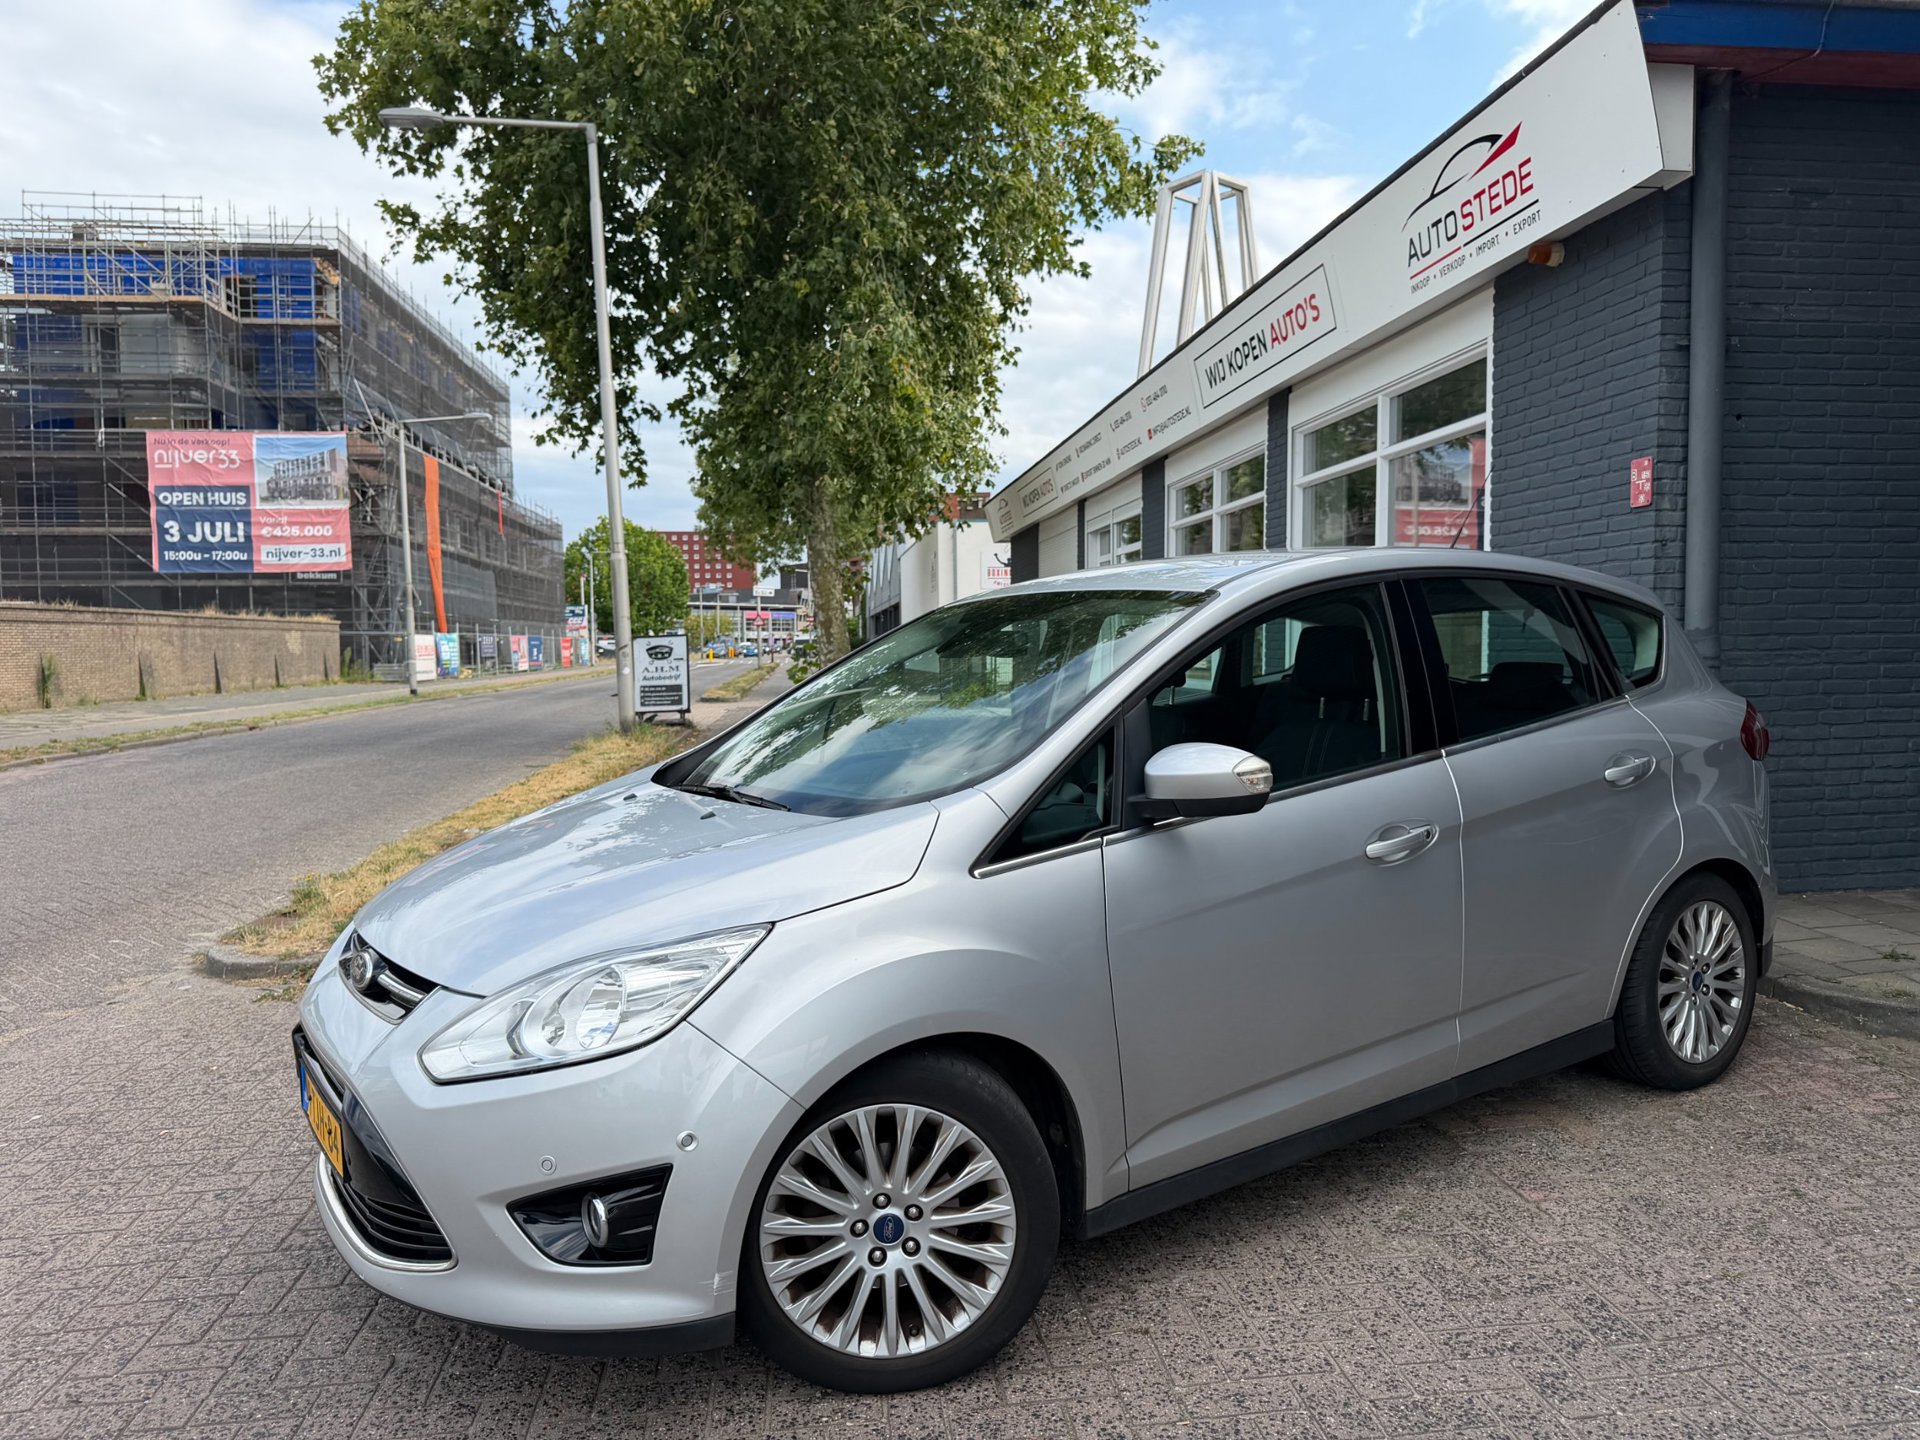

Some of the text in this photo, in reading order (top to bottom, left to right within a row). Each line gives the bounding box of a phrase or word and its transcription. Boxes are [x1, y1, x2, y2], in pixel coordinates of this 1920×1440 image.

[1407, 156, 1534, 268] AUTOSTEDE
[1410, 209, 1541, 295] INKOOP VERKOOP IMPORT EXPORT
[1204, 292, 1321, 390] WIJ KOPEN AUTO'S
[177, 437, 189, 446] de
[158, 491, 247, 506] OPEN HUIS
[163, 519, 246, 544] 3 JULI
[260, 525, 333, 538] €425.000
[163, 550, 202, 561] 15:00u
[211, 550, 248, 561] 17:00u
[266, 547, 342, 562] nijver-33.nl
